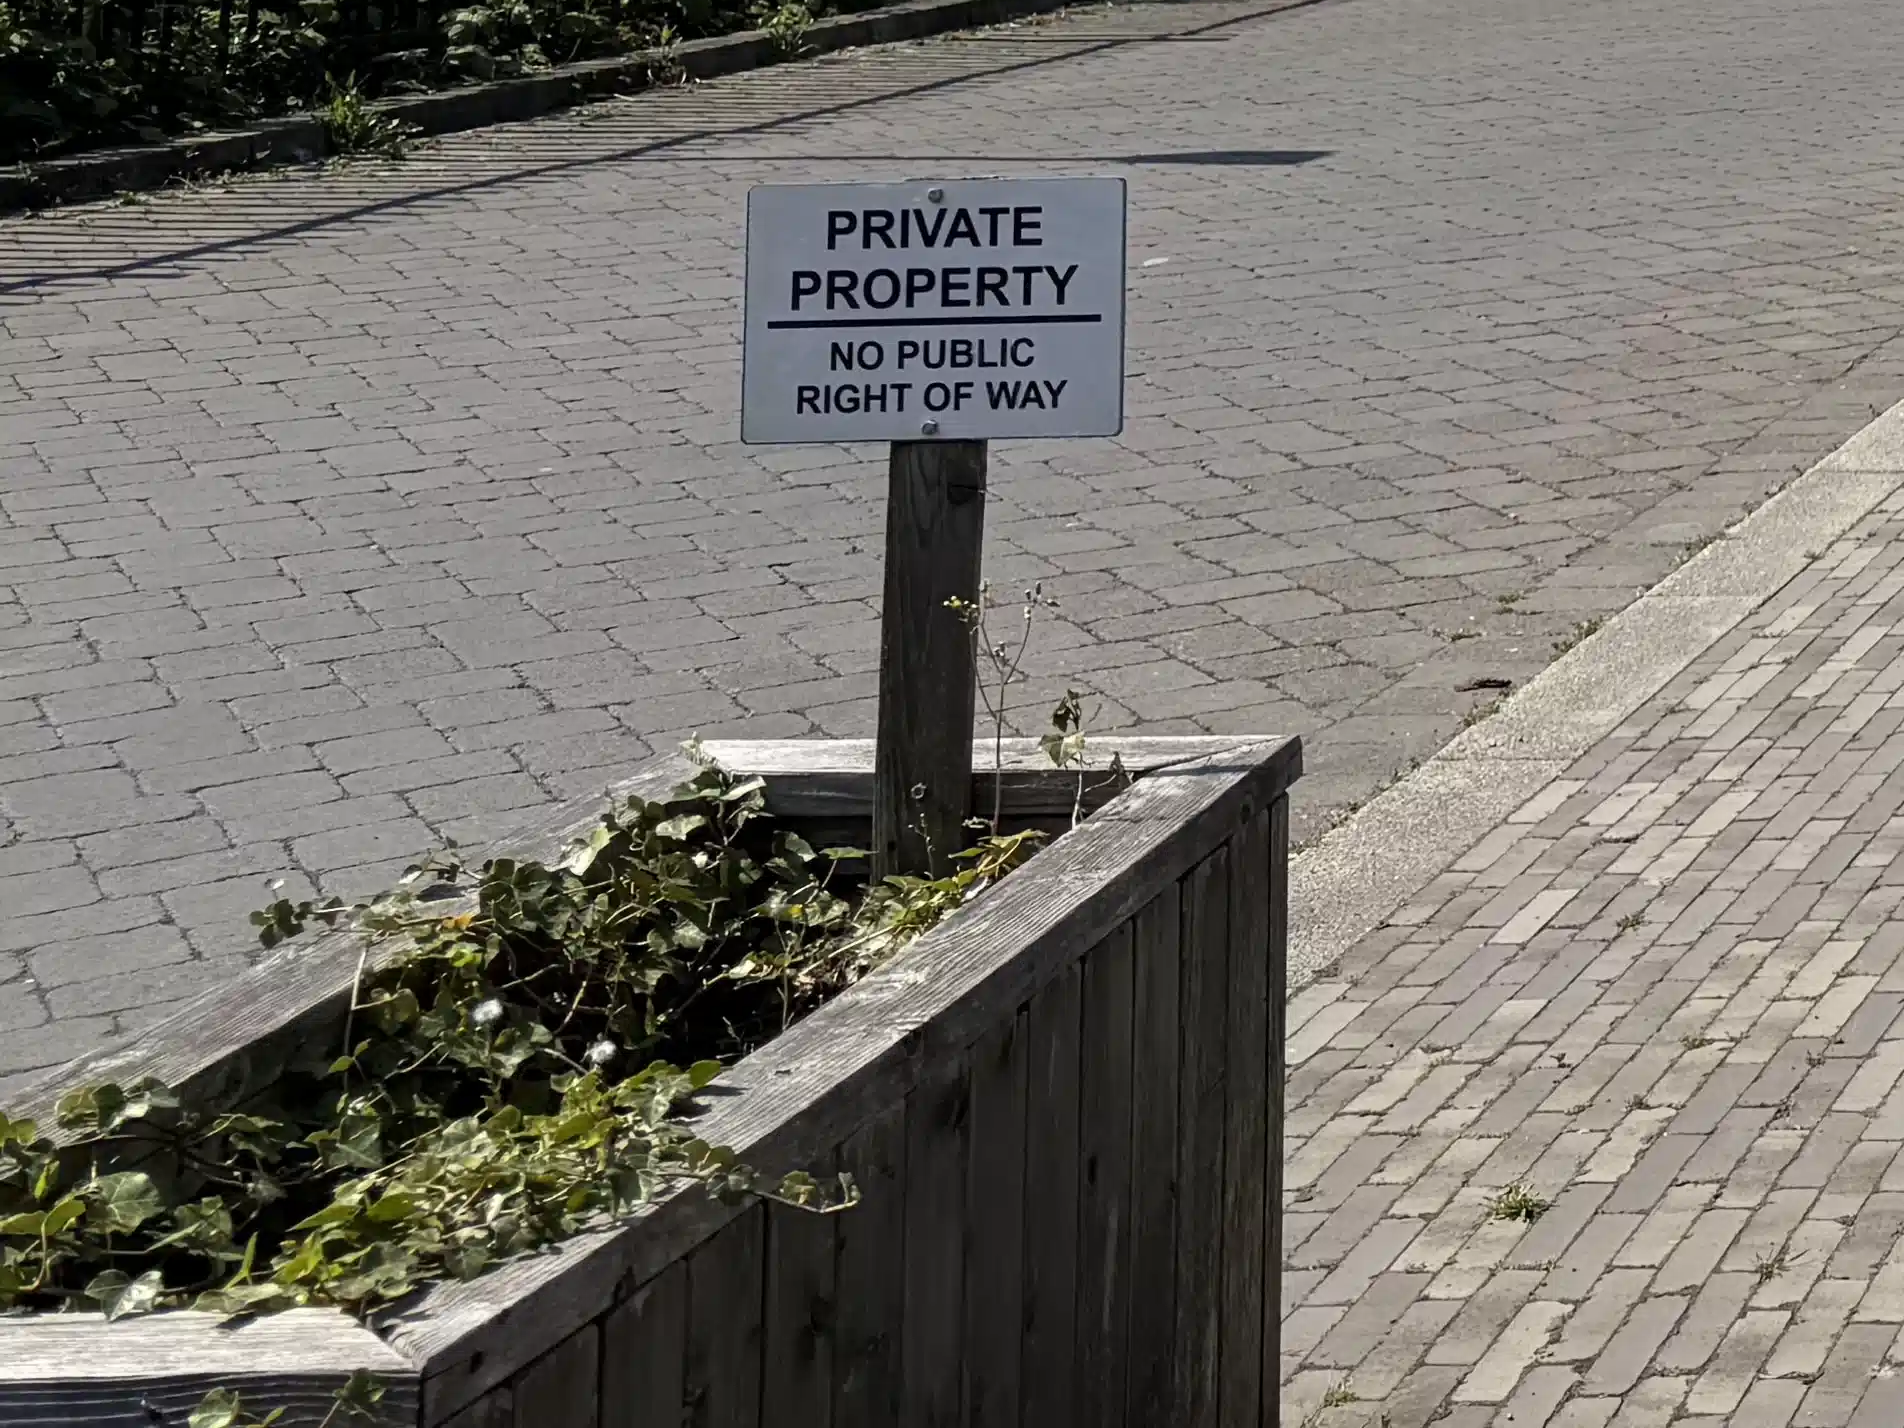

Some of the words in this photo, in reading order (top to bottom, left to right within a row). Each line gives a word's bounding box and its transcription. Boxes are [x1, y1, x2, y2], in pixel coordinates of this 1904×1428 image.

[827, 206, 1043, 251] PRIVATE
[791, 264, 1079, 311] PROPERTY
[829, 340, 884, 371] NO
[897, 337, 1035, 370] PUBLIC
[796, 383, 913, 415] RIGHT
[923, 381, 975, 412] OF
[985, 379, 1068, 410] WAY
